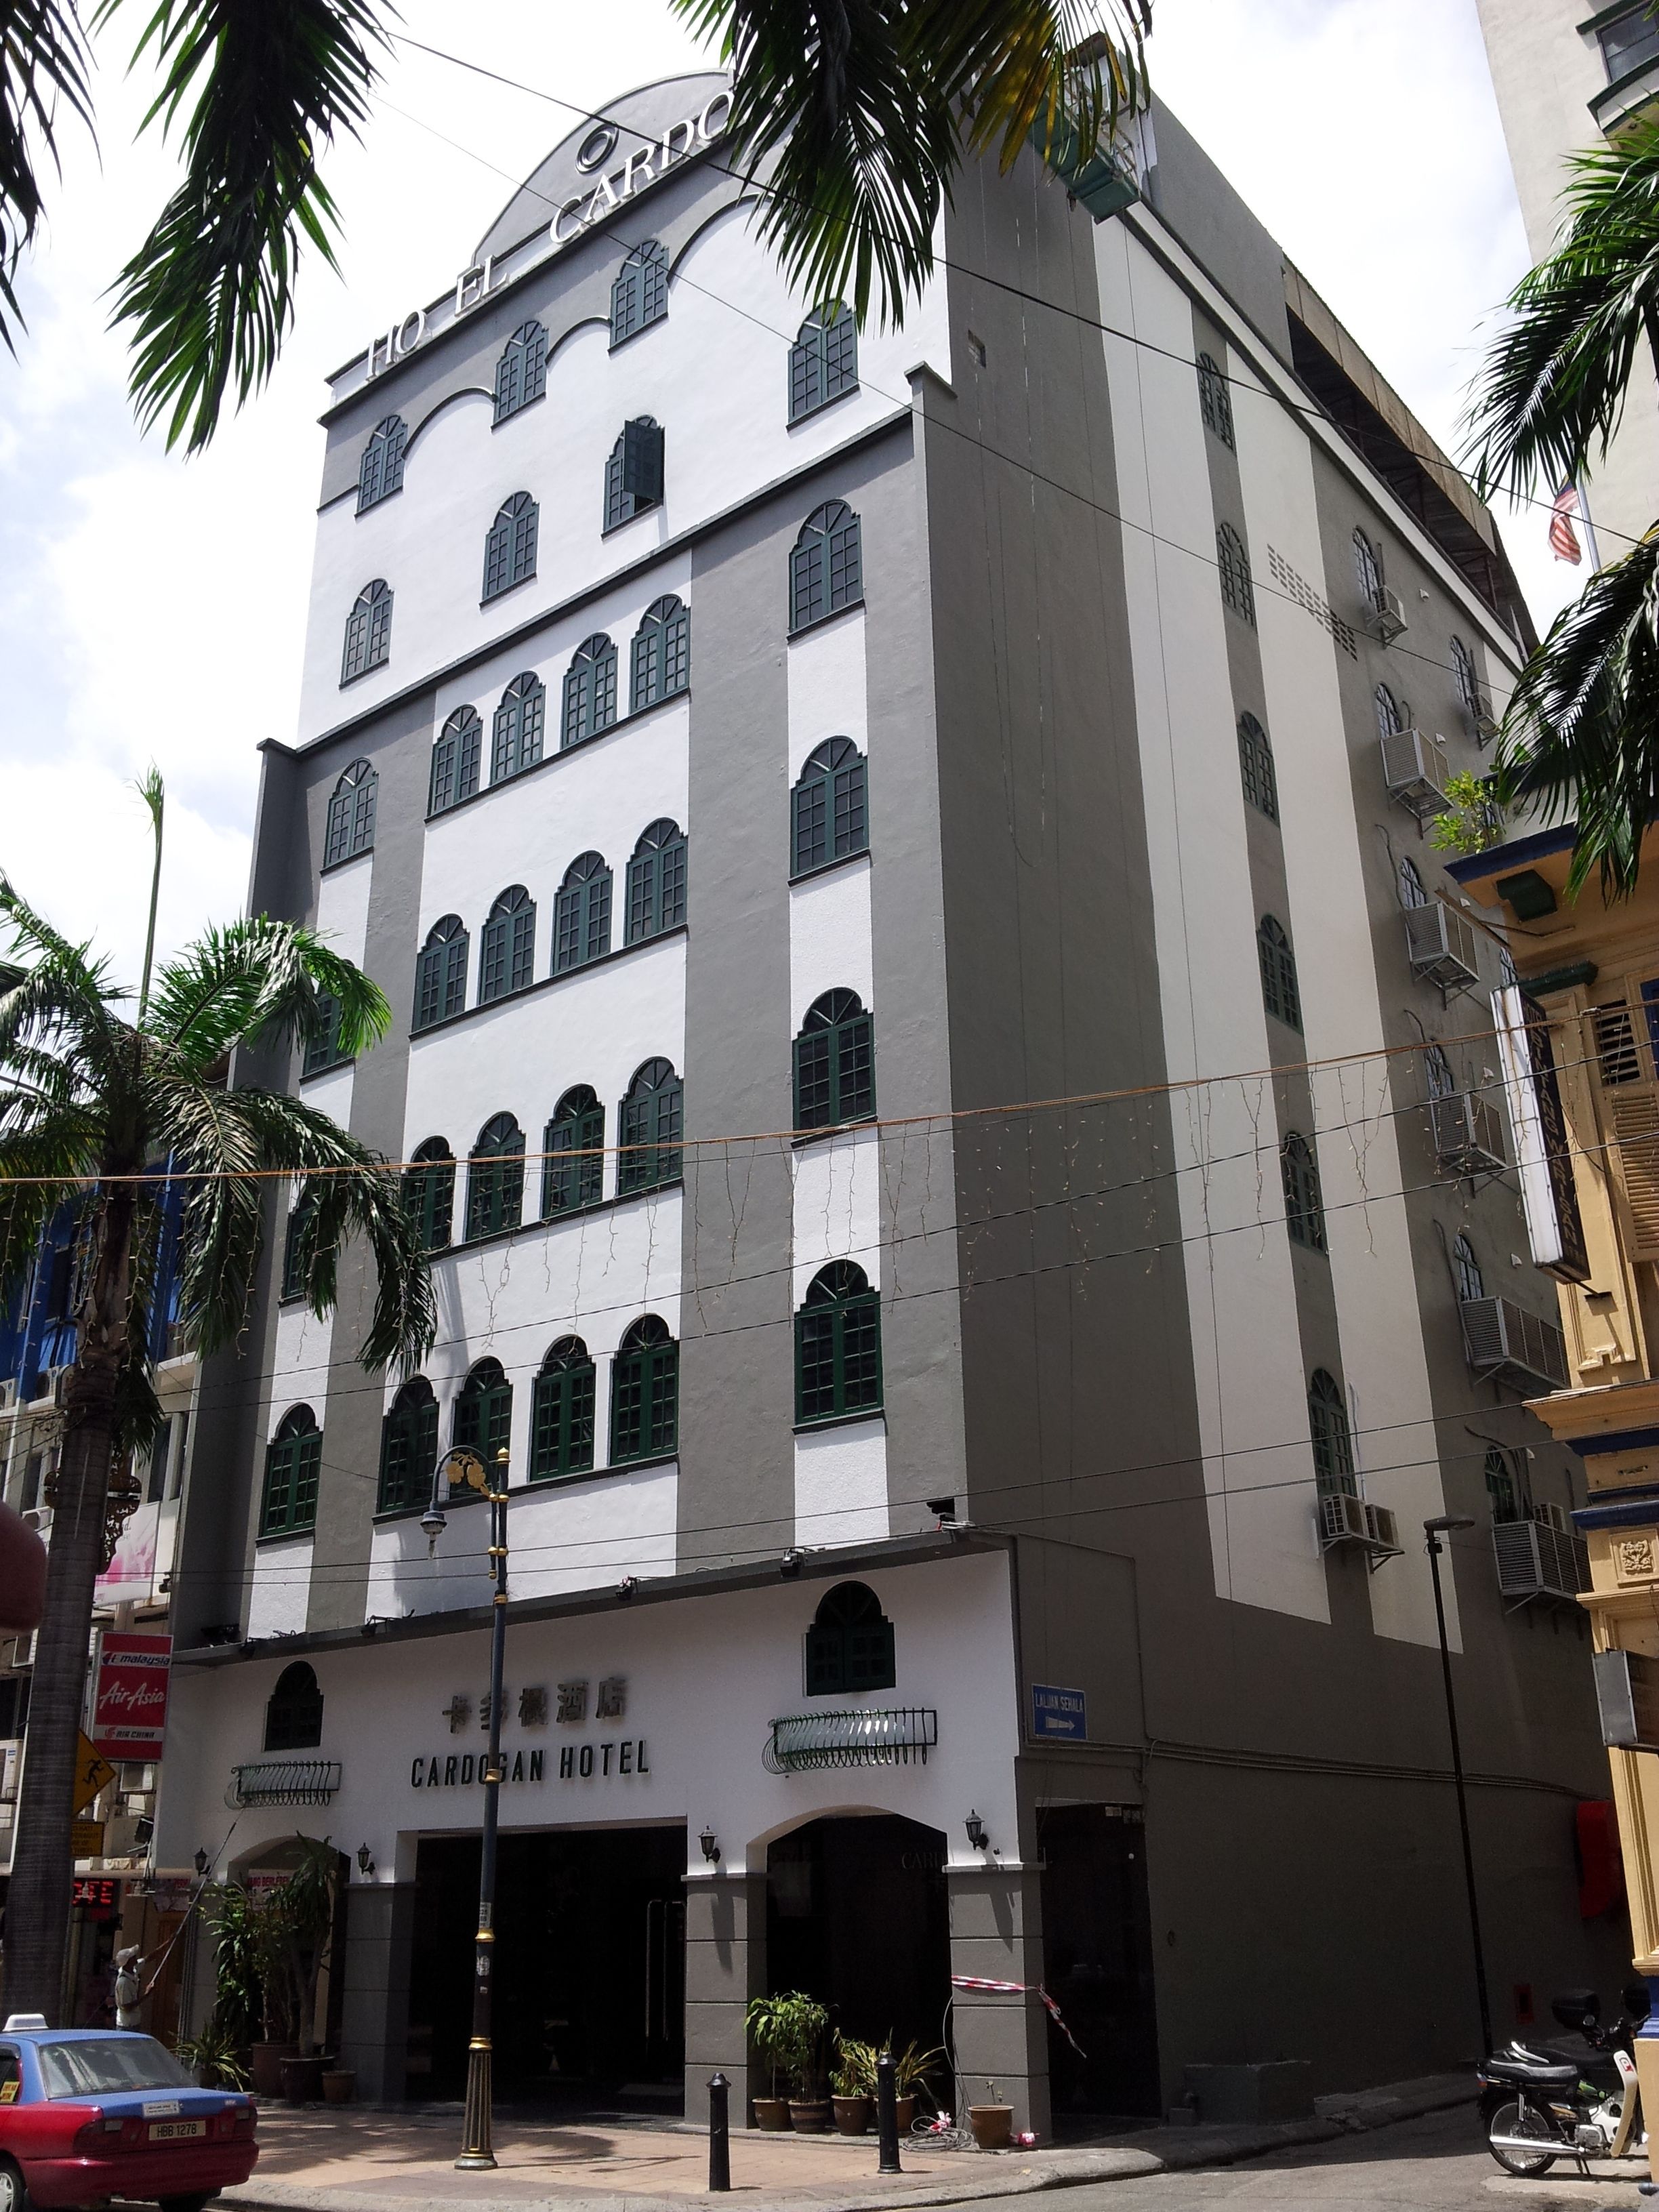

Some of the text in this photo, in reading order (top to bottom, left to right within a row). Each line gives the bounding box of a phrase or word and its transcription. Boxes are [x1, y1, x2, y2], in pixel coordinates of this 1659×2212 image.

[550, 91, 735, 245] CARDO
[120, 1654, 170, 1666] malaysia
[411, 1740, 649, 1787] CARDOGAN HOTEL
[157, 2123, 197, 2137] HBB 1278
